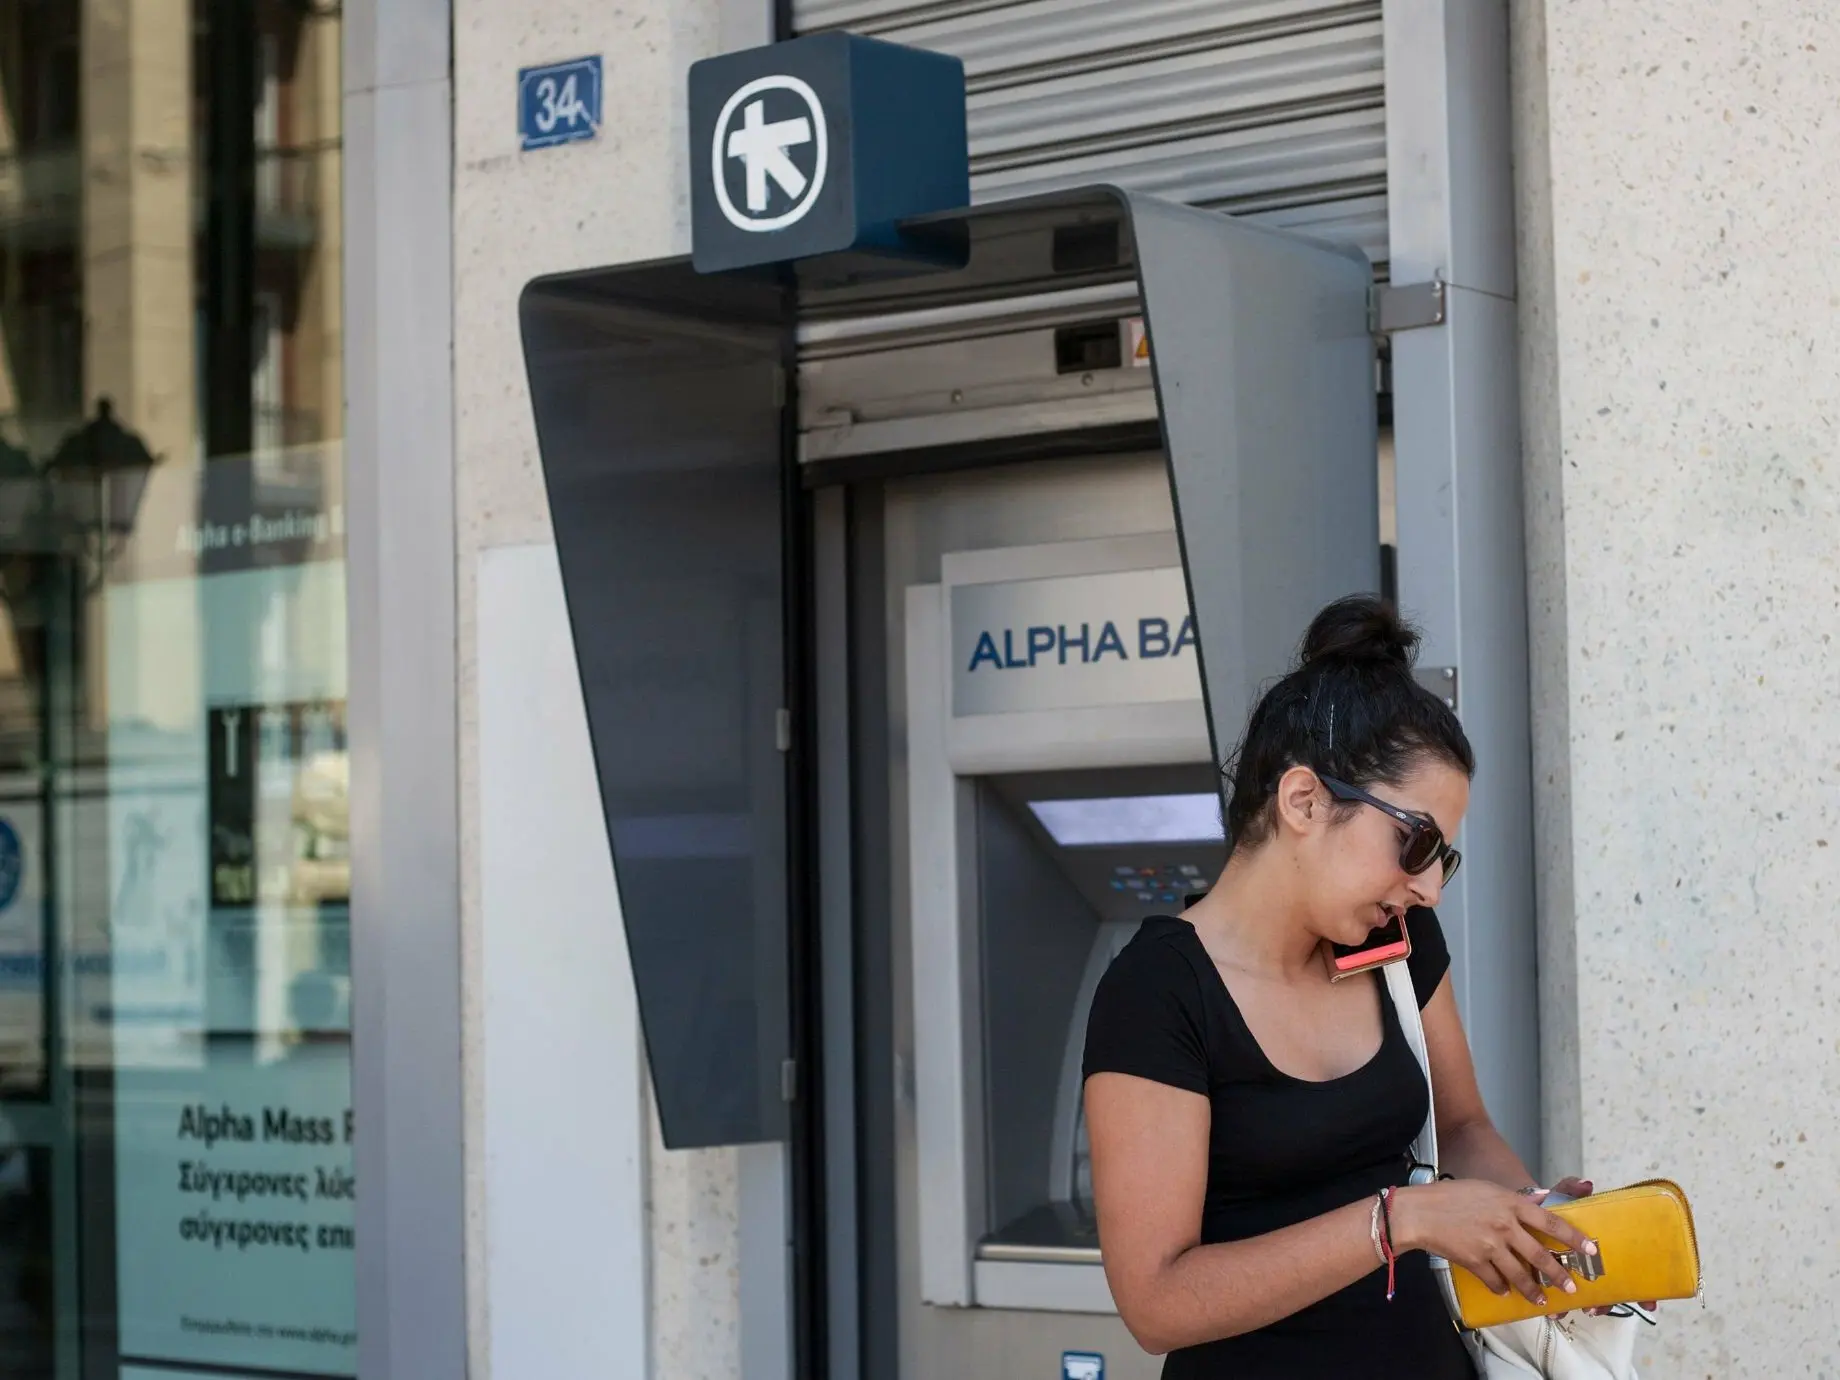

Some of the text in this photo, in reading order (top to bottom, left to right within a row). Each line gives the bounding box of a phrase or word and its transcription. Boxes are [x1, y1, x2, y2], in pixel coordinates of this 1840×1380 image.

[535, 74, 581, 133] 34
[968, 620, 1128, 672] ALPHA
[178, 1104, 254, 1150] Alpha
[262, 1105, 334, 1145] Mass
